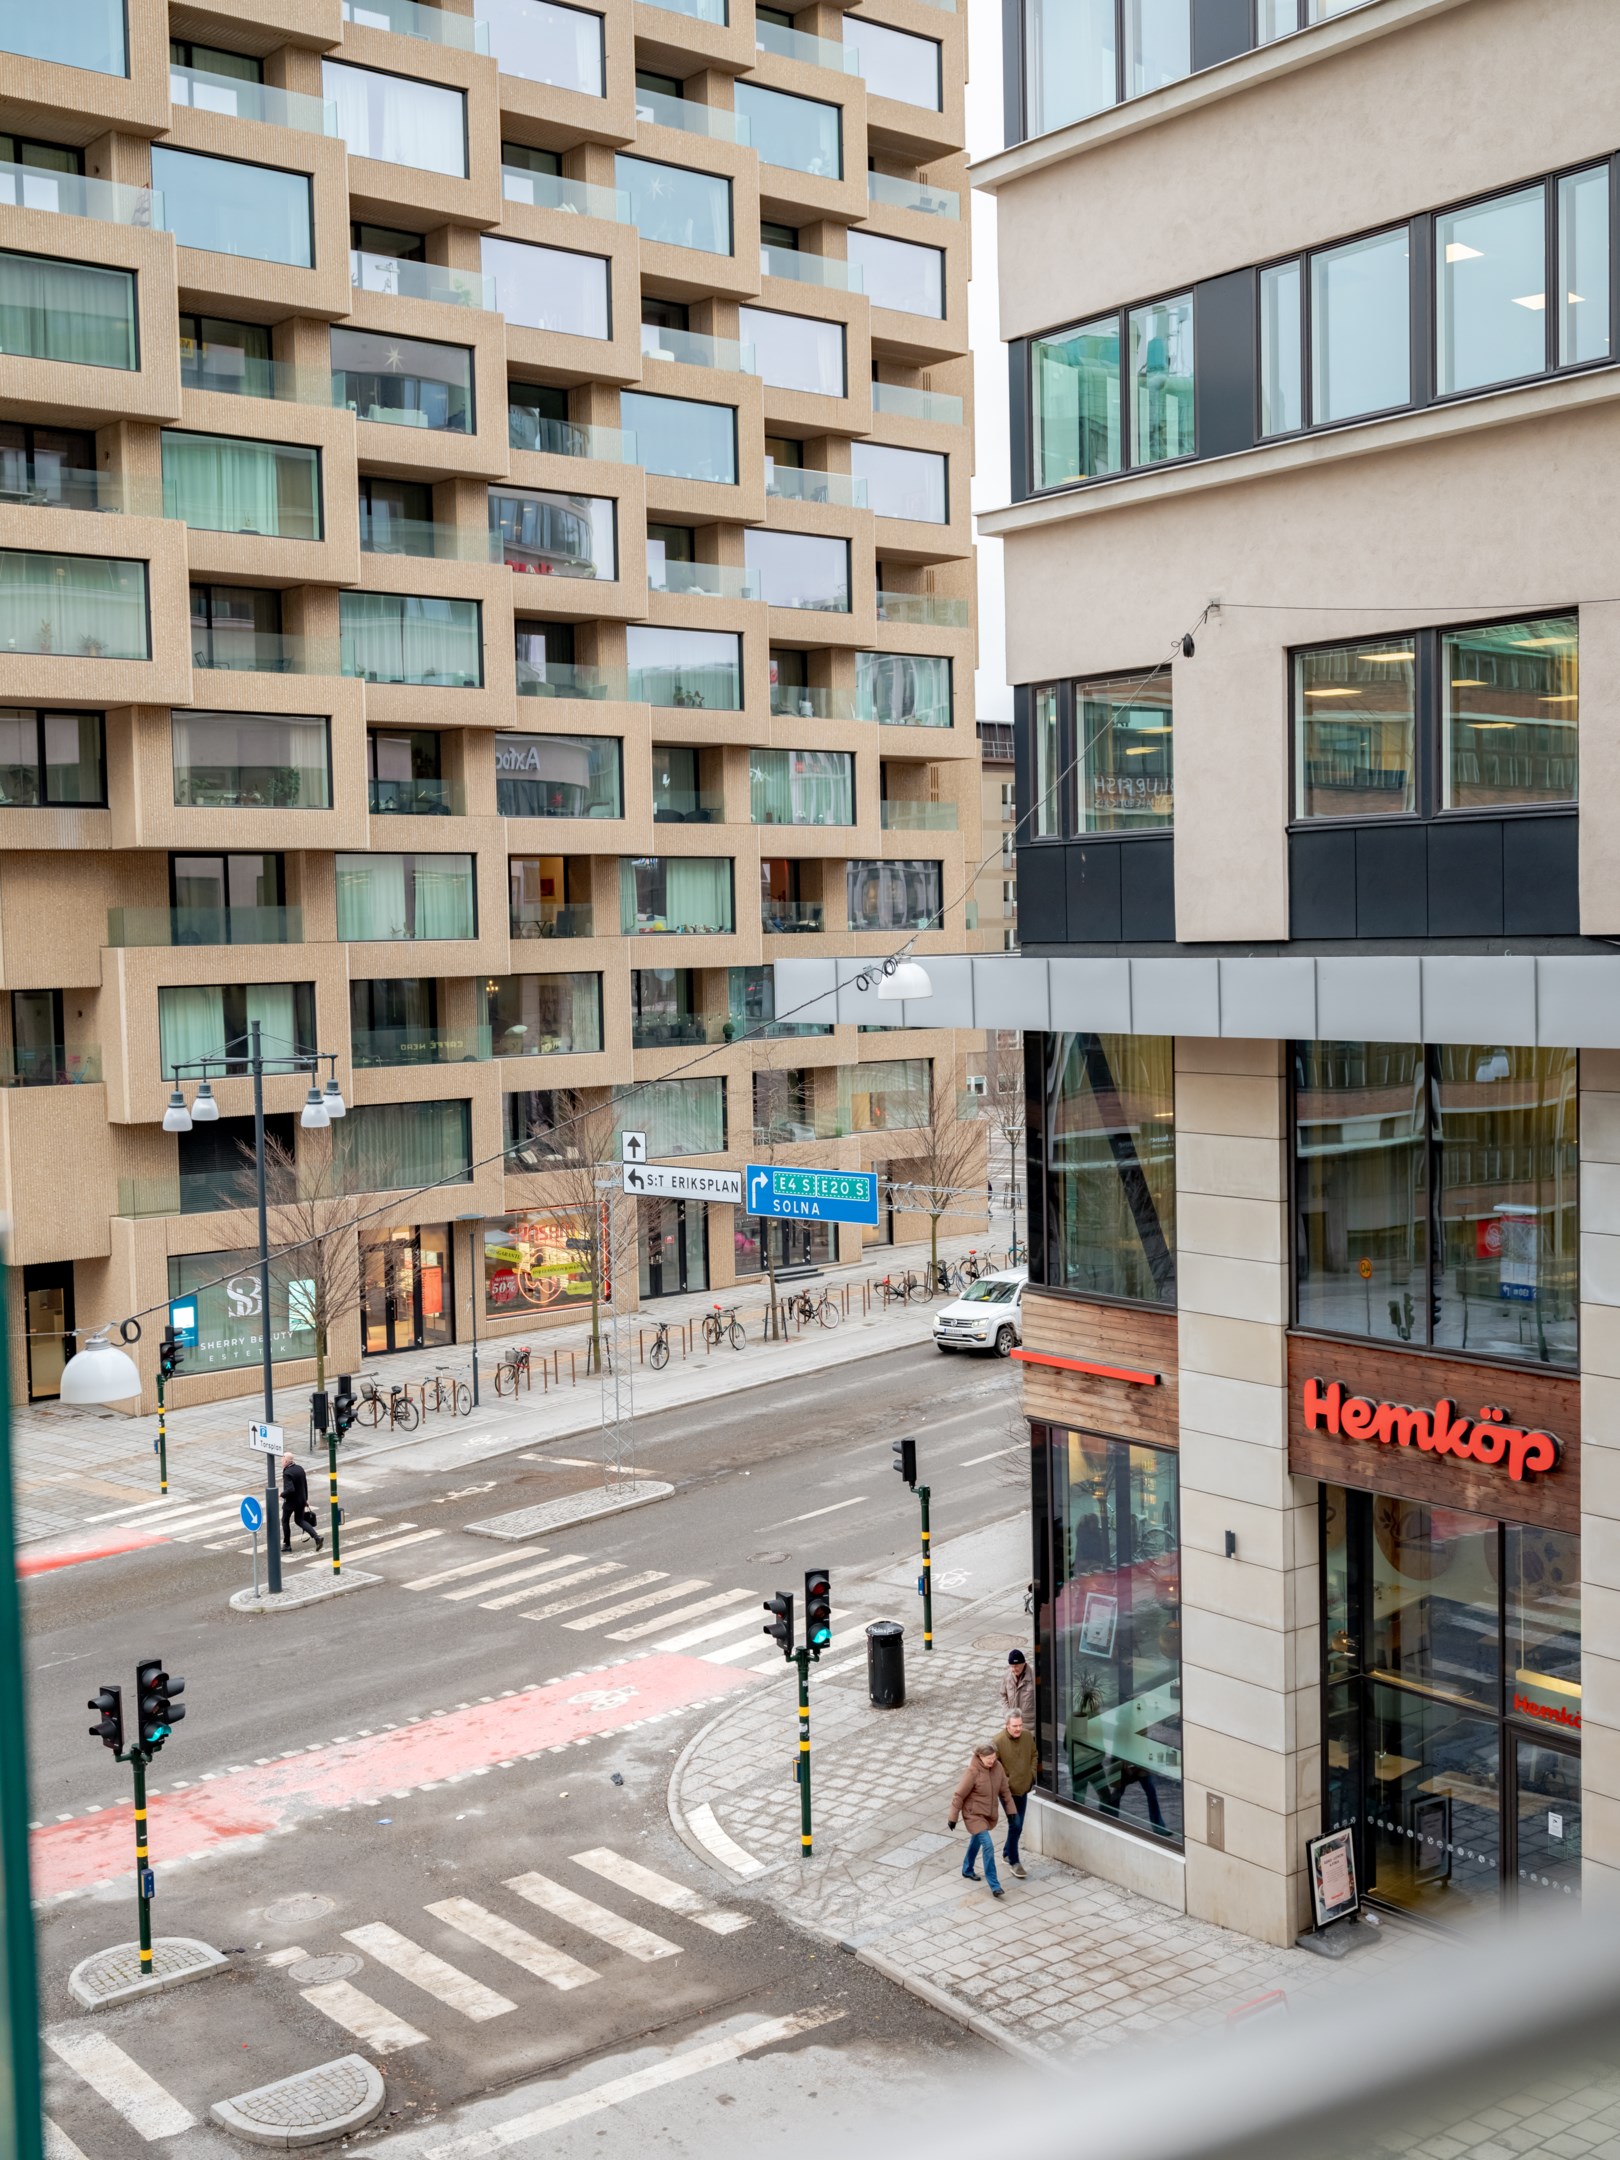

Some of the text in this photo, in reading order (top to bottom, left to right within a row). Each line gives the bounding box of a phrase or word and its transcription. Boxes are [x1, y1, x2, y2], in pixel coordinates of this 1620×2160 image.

[647, 1173, 739, 1194] S:T ERIKSPLAN
[779, 1178, 810, 1192] E4 S
[821, 1180, 864, 1196] E20 S
[773, 1199, 820, 1216] SOLNA
[491, 1280, 516, 1294] 50%
[200, 1331, 294, 1351] SHERRY BEUTY
[1303, 1377, 1559, 1482] Hemköp
[260, 1440, 282, 1452] Torsplan
